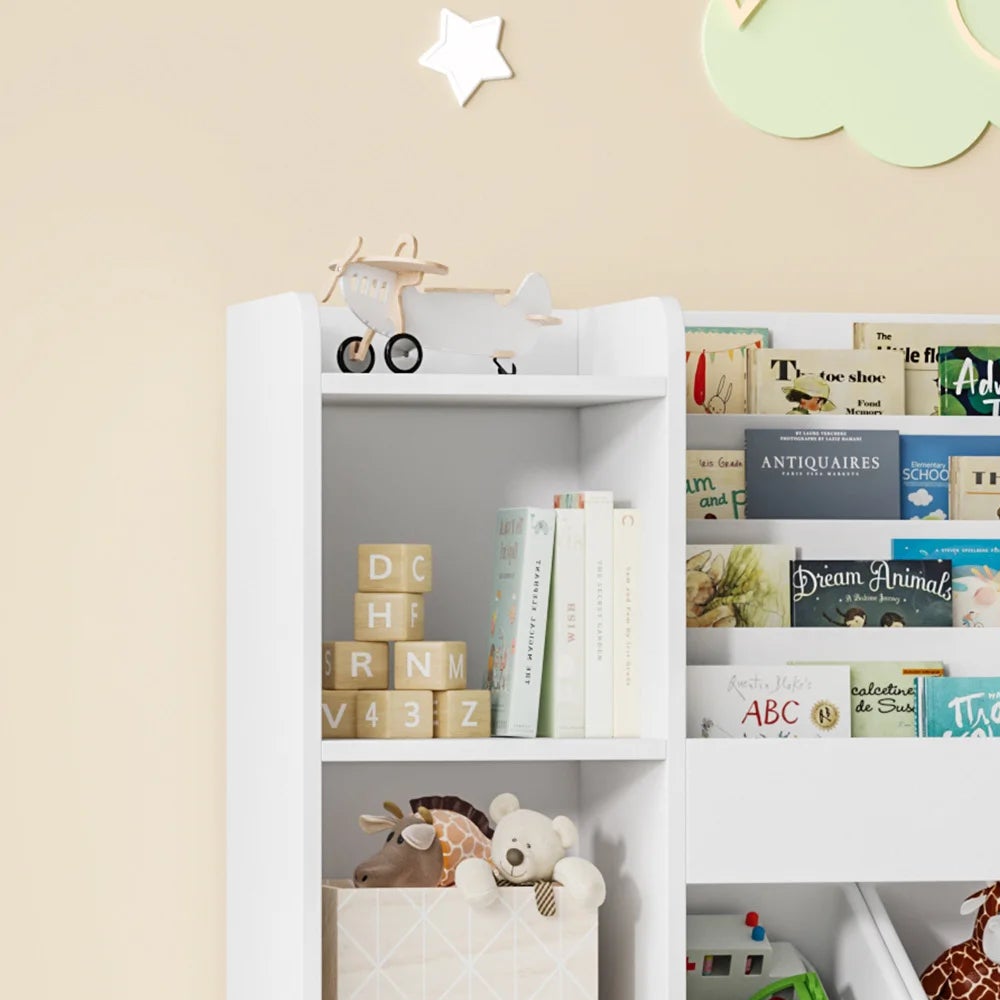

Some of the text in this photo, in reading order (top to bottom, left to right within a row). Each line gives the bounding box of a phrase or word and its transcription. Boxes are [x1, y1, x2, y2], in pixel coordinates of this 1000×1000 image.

[876, 332, 892, 340] The
[924, 347, 940, 363] fl
[819, 370, 886, 383] toe shoe
[857, 400, 881, 408] Fond
[761, 455, 880, 471] ANTIQUAIRES
[911, 461, 946, 469] Elementary
[699, 493, 728, 508] and
[369, 554, 393, 580] D
[412, 555, 425, 582] C
[792, 560, 953, 602] Dream Animals
[368, 602, 392, 628] H
[411, 602, 418, 628] F
[351, 652, 374, 677] R
[406, 652, 432, 678] N
[449, 653, 465, 680] M
[321, 703, 347, 729] V
[365, 701, 379, 728] 4
[404, 701, 420, 727] 3
[461, 701, 479, 727] Z
[741, 699, 800, 726] ABC
[855, 700, 873, 712] de
